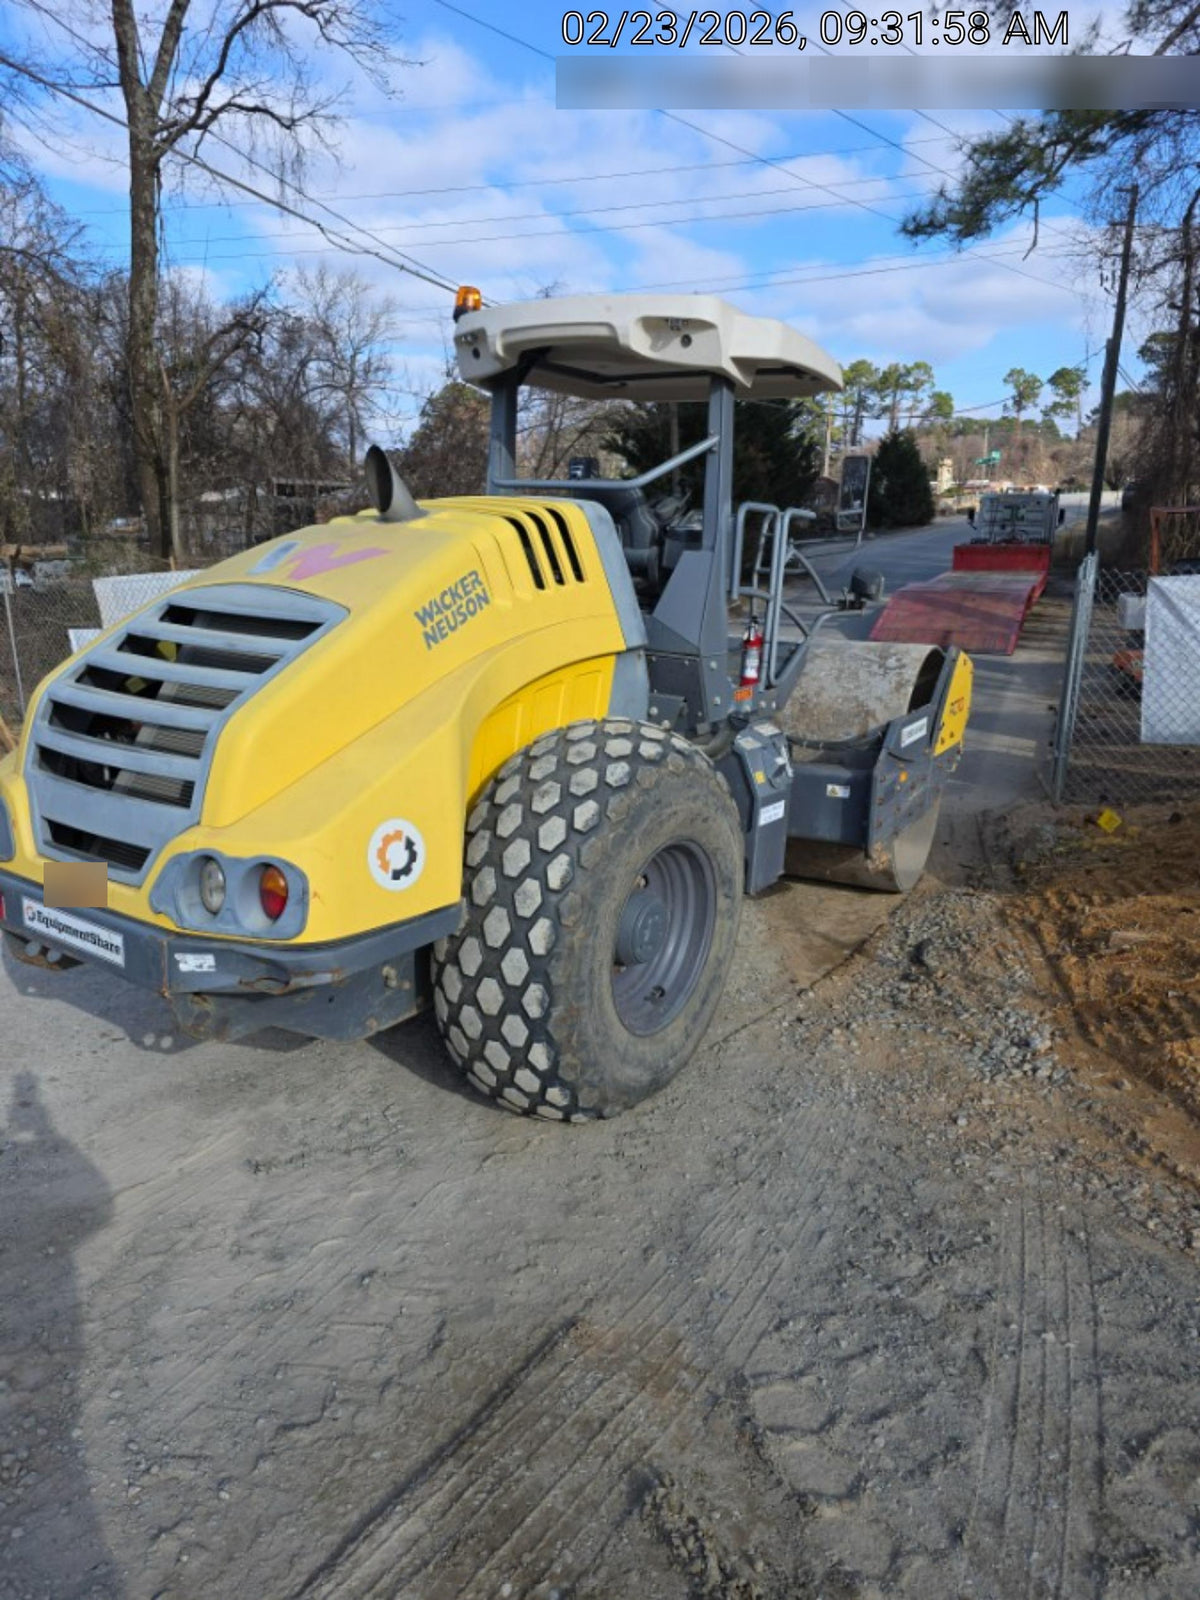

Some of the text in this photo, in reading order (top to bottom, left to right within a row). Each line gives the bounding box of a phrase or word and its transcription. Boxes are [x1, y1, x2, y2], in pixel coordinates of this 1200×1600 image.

[414, 570, 483, 628] WACKER
[423, 587, 491, 651] NEUSON
[36, 910, 120, 955] EquipmentShare
